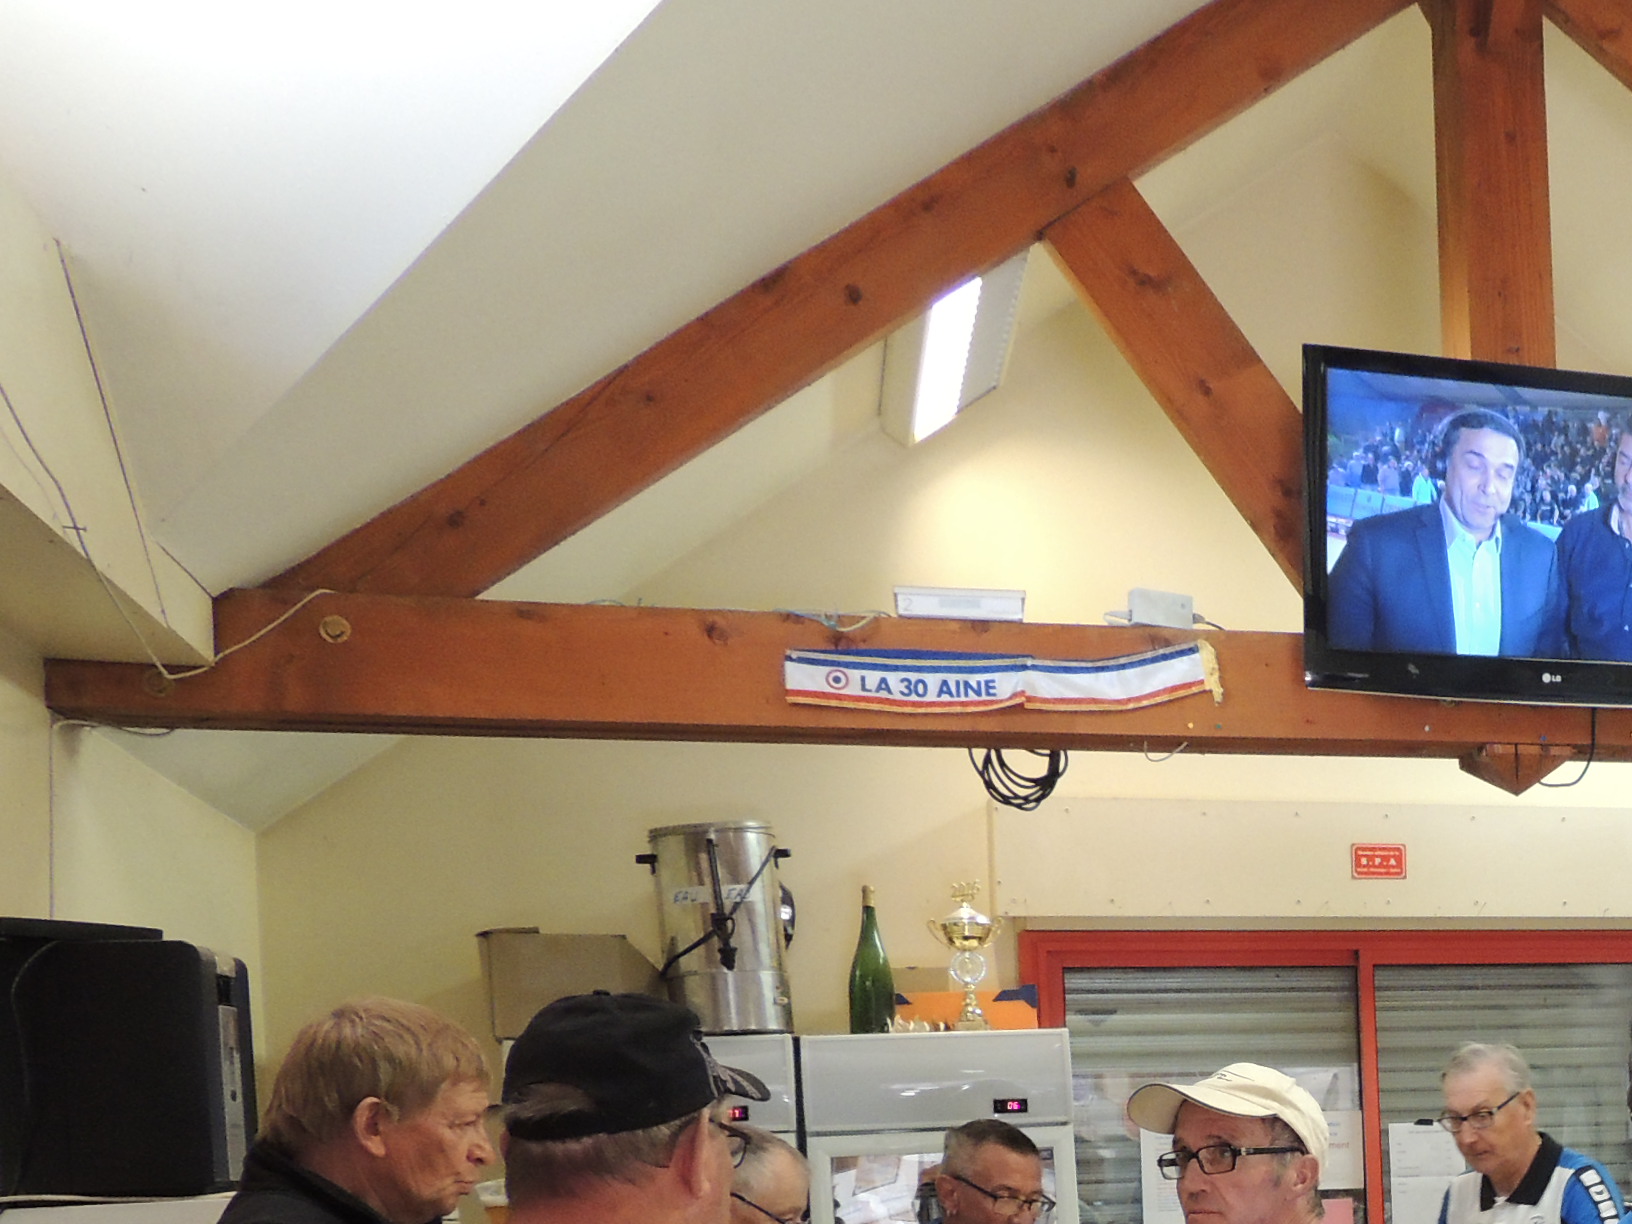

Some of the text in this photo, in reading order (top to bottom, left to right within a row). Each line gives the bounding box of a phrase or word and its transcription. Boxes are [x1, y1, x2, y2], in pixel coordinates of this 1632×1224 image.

[860, 675, 998, 698] LA 30 AINE
[1007, 1101, 1021, 1110] 06
